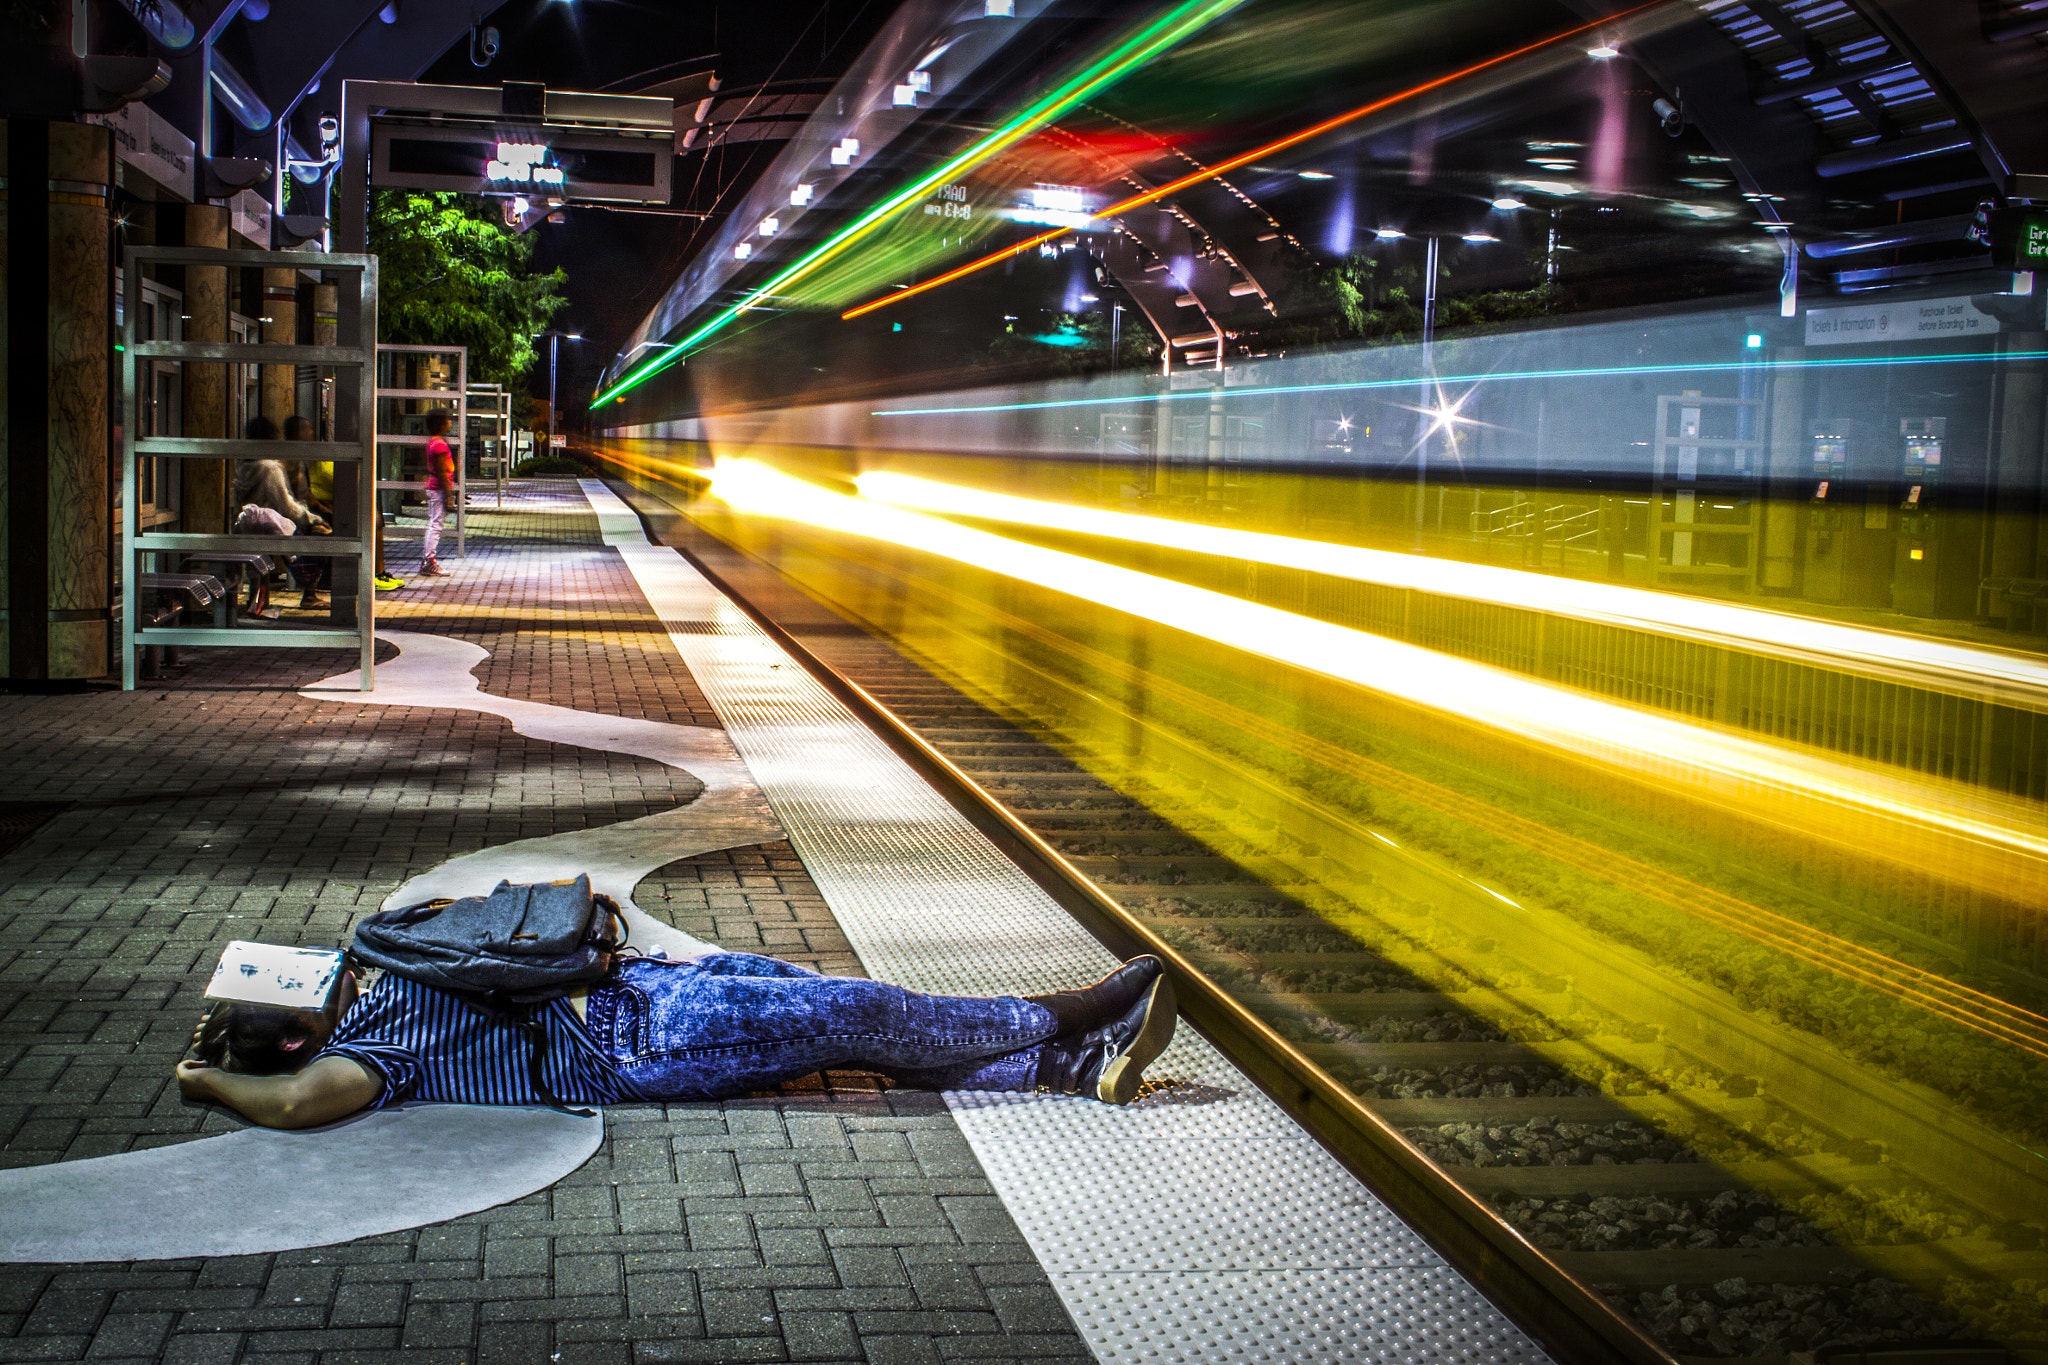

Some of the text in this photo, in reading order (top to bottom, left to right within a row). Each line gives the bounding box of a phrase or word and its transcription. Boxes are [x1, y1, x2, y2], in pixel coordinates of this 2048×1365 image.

[1919, 304, 1964, 317] Purchase Ticket
[1812, 319, 1831, 333] Tickets
[1840, 317, 1875, 332] Information
[1919, 318, 1979, 331] Before Boarding Train
